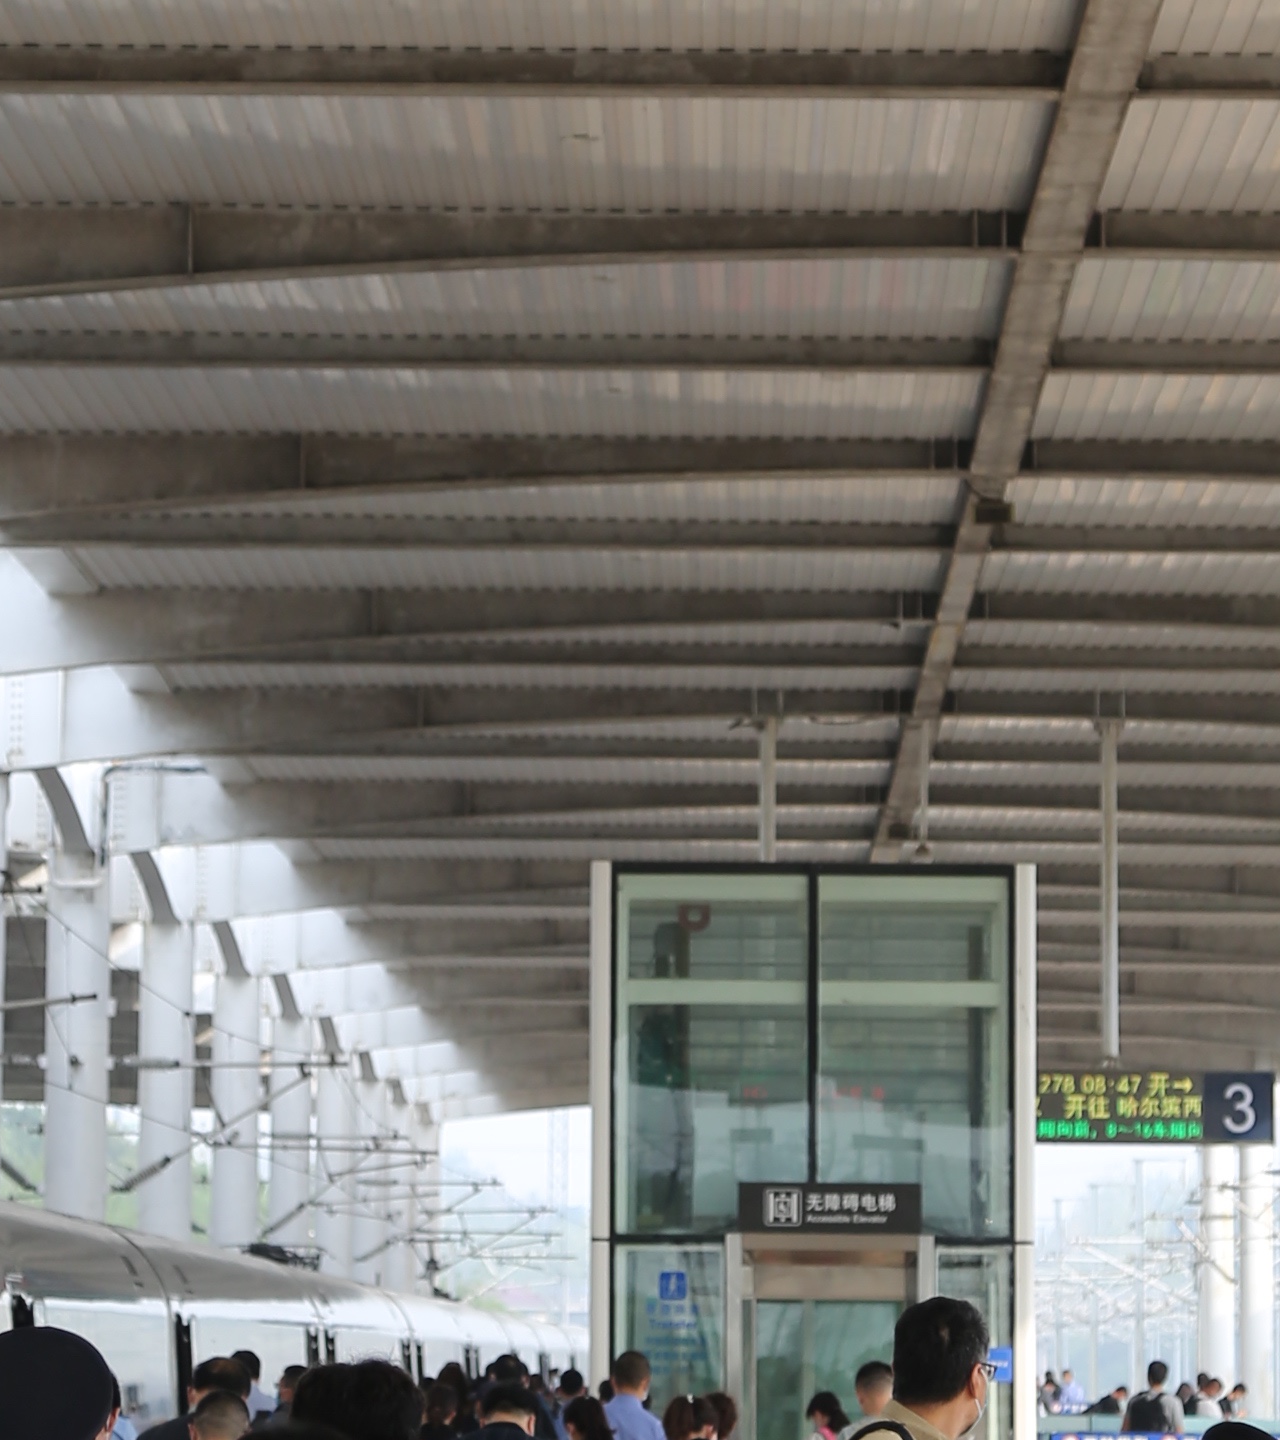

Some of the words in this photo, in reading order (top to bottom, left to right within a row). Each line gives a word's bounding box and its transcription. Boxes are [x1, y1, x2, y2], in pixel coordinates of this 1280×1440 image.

[1148, 1071, 1170, 1097] 开
[1064, 1094, 1111, 1119] 开往
[1116, 1095, 1202, 1119] 哈尔滨西
[1223, 1082, 1257, 1134] 3
[807, 1192, 897, 1213] 无障碍电梯
